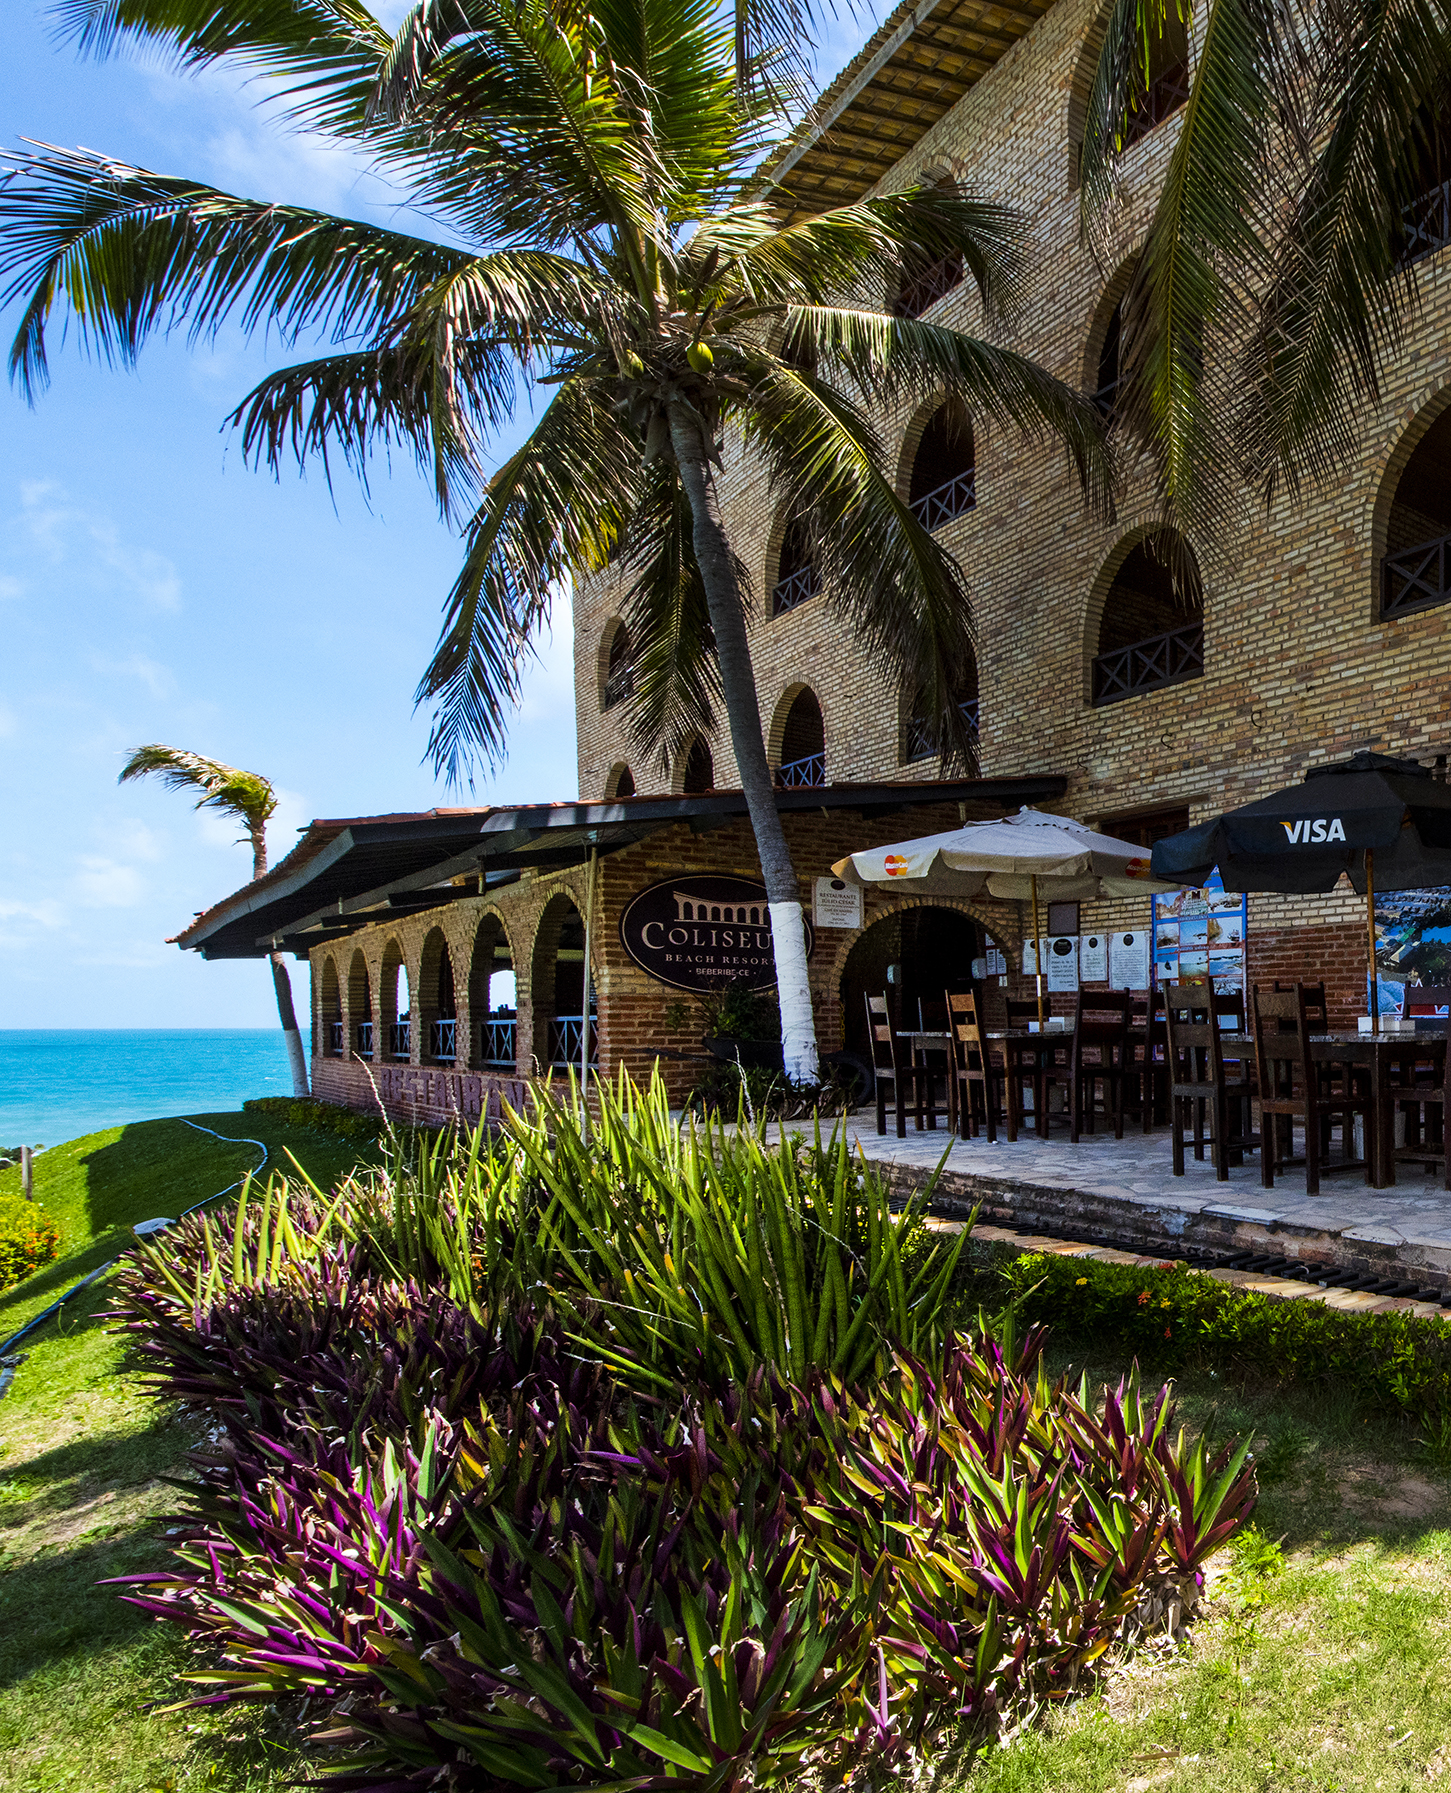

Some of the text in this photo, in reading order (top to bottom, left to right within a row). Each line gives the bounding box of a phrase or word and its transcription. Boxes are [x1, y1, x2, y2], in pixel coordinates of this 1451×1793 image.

[1280, 818, 1347, 844] VISA
[641, 921, 774, 950] COLISEU
[665, 954, 715, 964] BEACH
[380, 1067, 526, 1118] RESTAURAN
